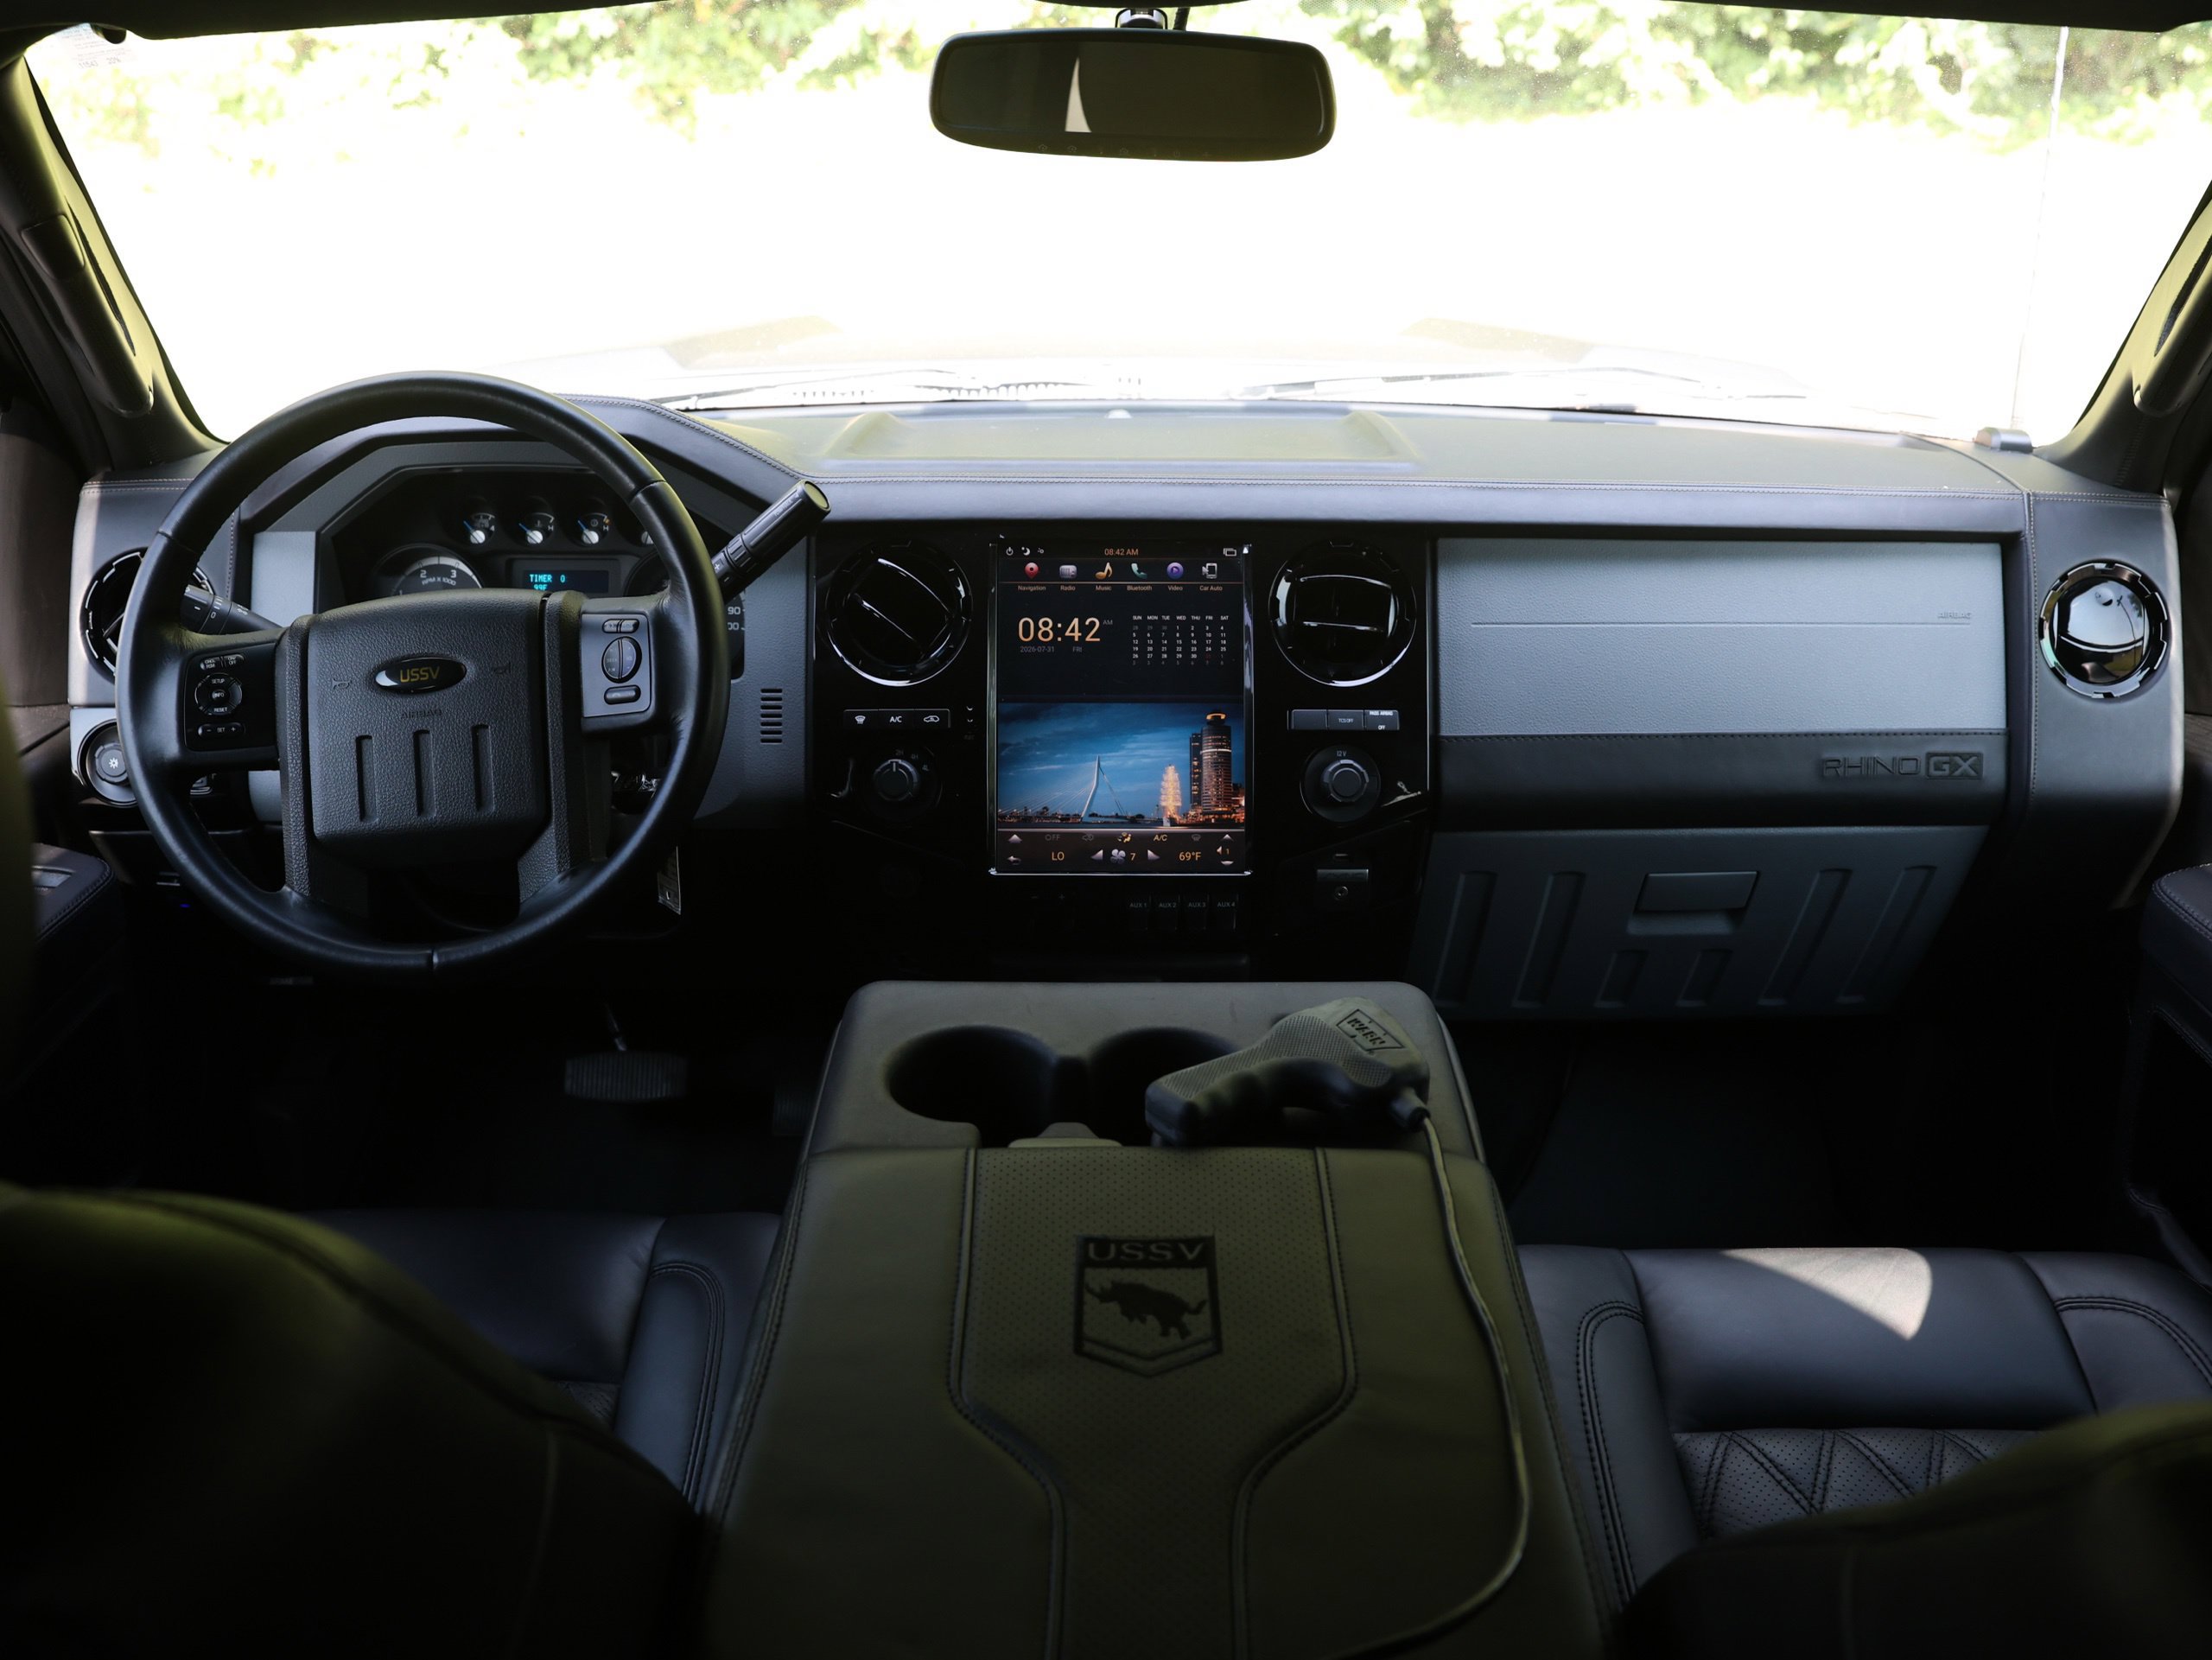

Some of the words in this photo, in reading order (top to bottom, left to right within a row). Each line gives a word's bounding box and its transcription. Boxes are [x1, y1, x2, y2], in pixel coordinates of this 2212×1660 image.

[420, 569, 427, 578] 2
[450, 569, 457, 578] 3
[529, 574, 552, 583] TIMER
[727, 606, 741, 615] 90
[727, 622, 739, 630] 00
[1018, 617, 1100, 642] 08:42
[399, 665, 440, 683] USSV
[1823, 756, 1921, 776] RHINO
[1928, 755, 1978, 776] GX
[1051, 852, 1065, 861] LO
[1130, 852, 1136, 861] 7
[1179, 852, 1201, 861] 69°F
[1087, 1241, 1206, 1262] USSV
